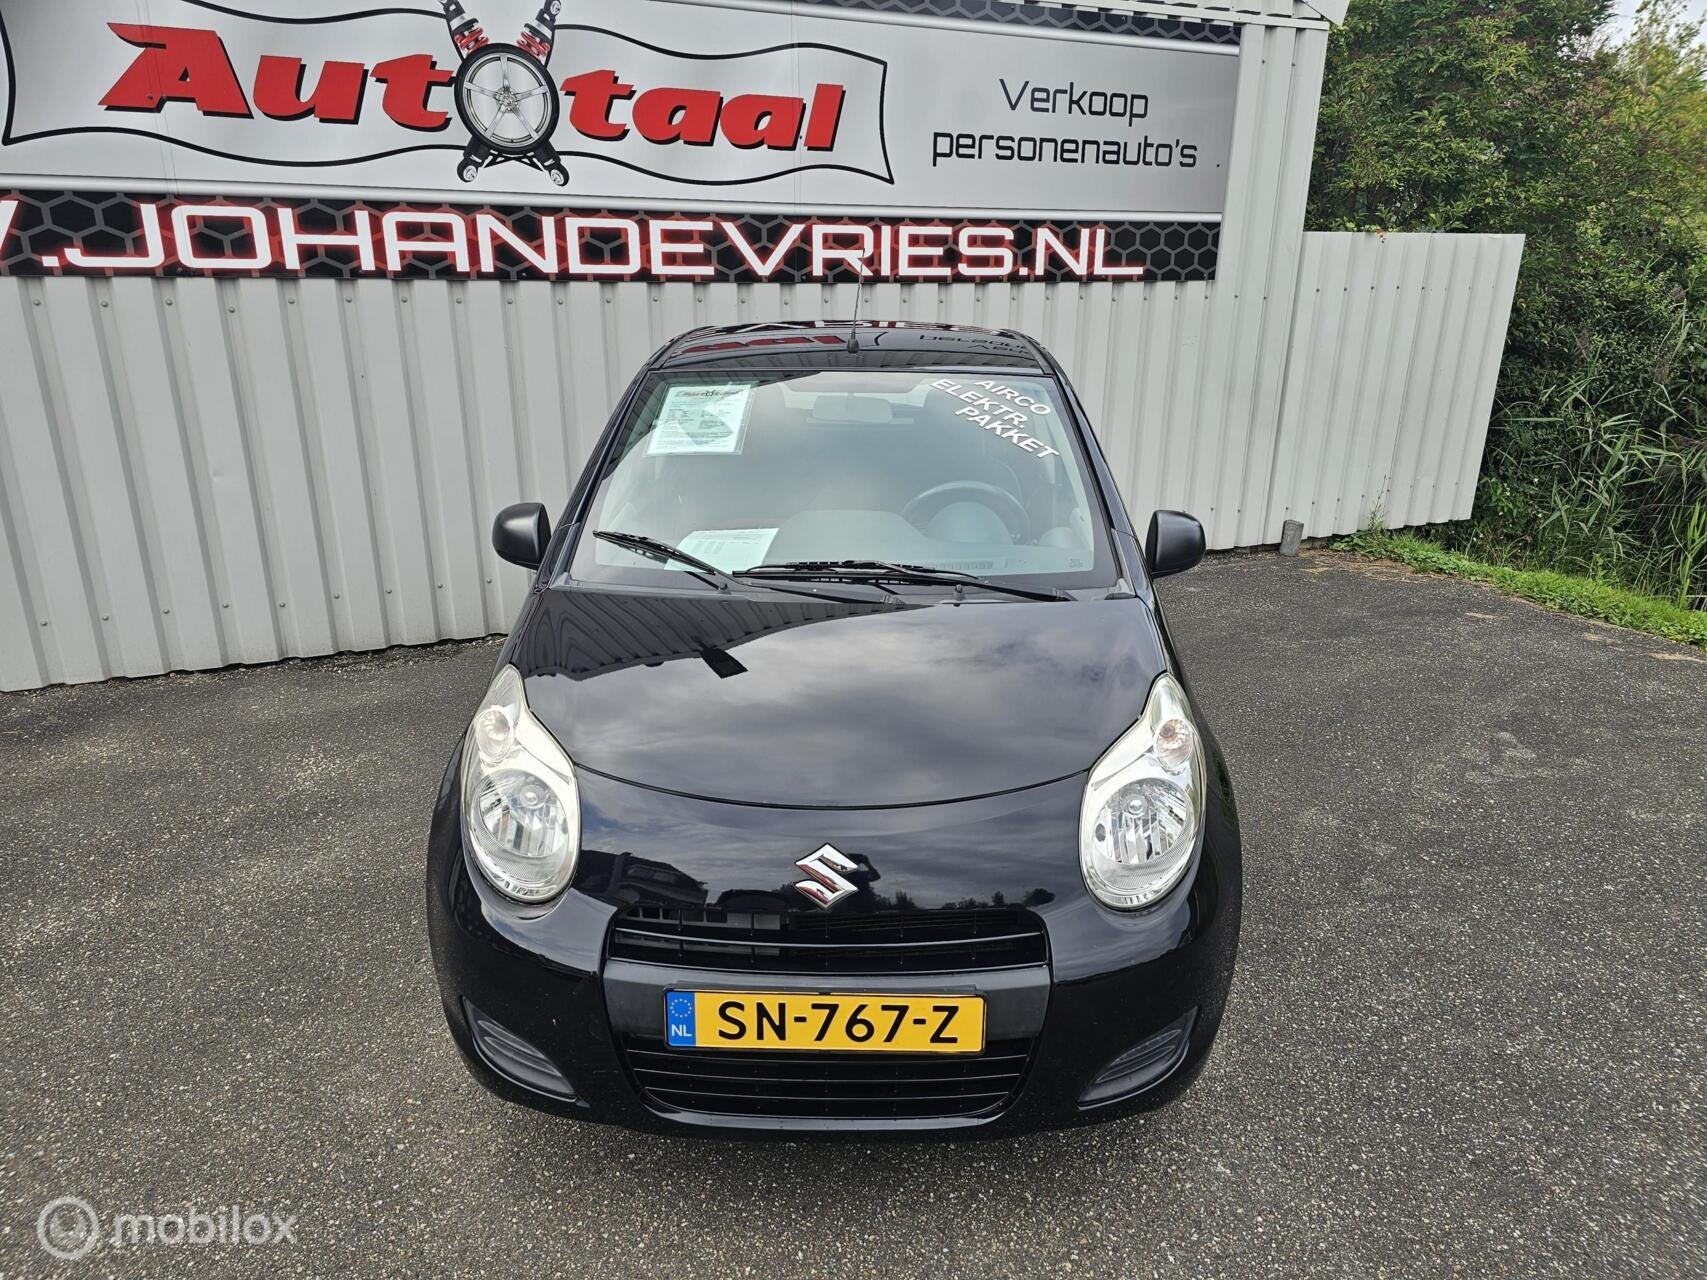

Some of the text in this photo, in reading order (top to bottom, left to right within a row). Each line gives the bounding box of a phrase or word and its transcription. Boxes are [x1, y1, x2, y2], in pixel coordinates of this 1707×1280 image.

[998, 77, 1149, 120] Verkoop
[932, 130, 1198, 168] personenauto's
[0, 199, 1145, 277] .JOHANDEVRIES.NL
[930, 378, 1029, 428] ELEKTR.
[973, 379, 1051, 415] AIRCO
[954, 406, 1060, 458] PAKKET
[671, 1000, 960, 1044] NL SN-767-Z
